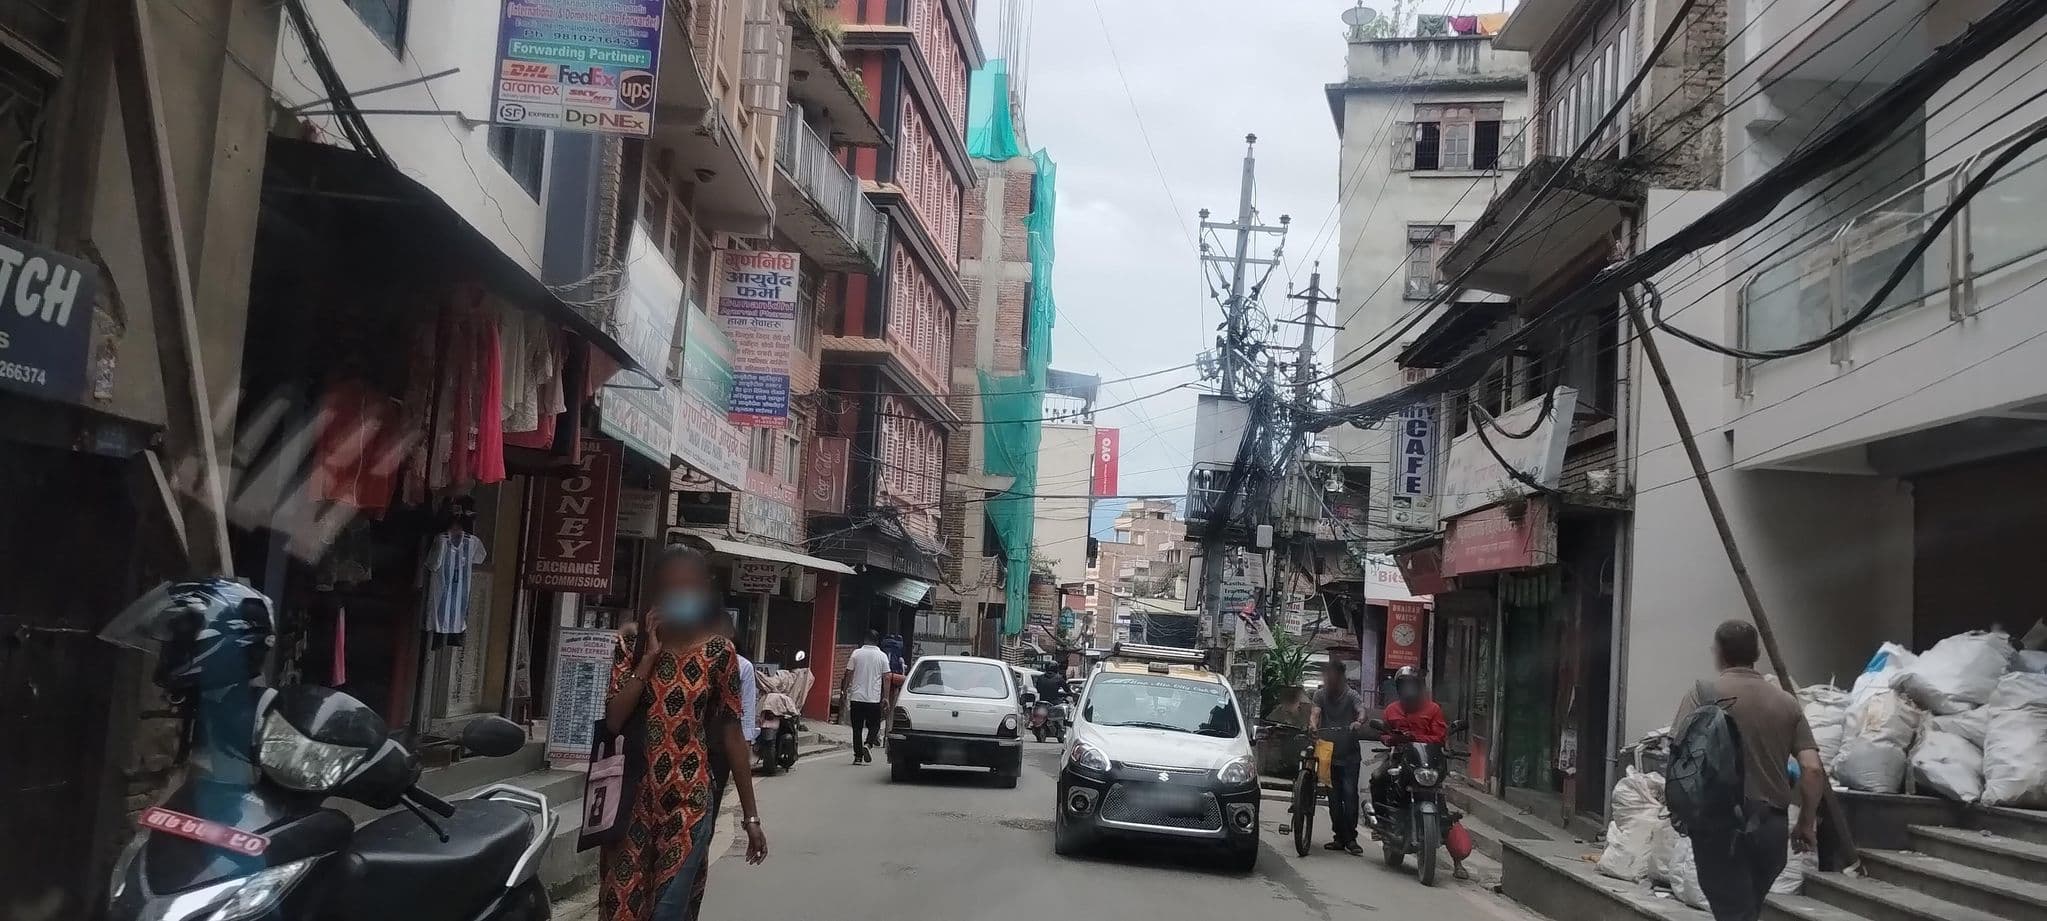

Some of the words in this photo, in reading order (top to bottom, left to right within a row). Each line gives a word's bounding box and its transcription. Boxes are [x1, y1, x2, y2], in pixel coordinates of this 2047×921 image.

[512, 42, 585, 61] Forwarding
[589, 48, 646, 64] Partiner:
[510, 63, 550, 79] DHL
[558, 65, 616, 88] FedEx
[502, 82, 560, 96] aramex
[622, 82, 651, 104] ups
[504, 107, 521, 117] SF
[566, 109, 644, 130] DpNEx
[1102, 437, 1111, 462] OYO
[1406, 419, 1428, 494] CAFE
[536, 560, 601, 576] EXCHANGE
[528, 574, 543, 585] NO
[544, 575, 609, 589] COMMISSION
